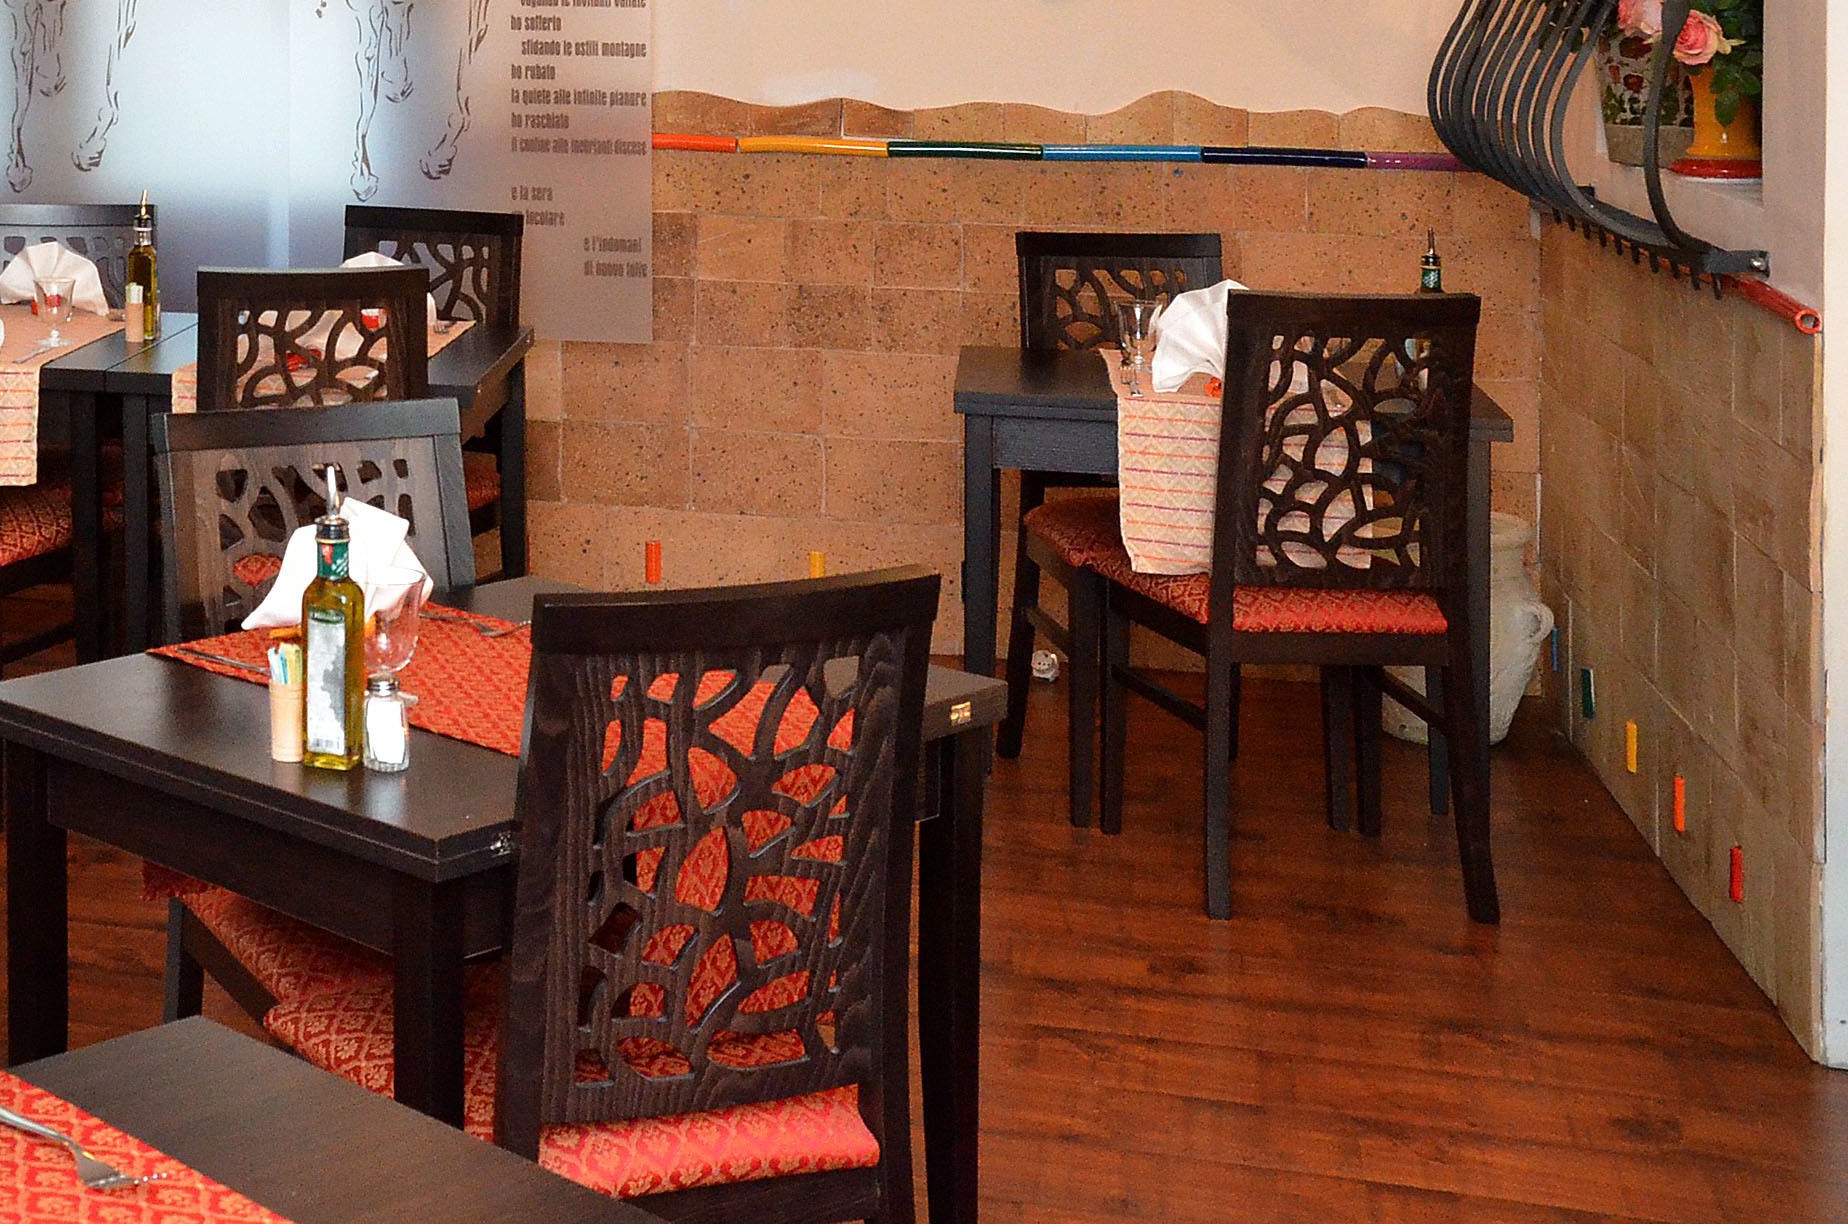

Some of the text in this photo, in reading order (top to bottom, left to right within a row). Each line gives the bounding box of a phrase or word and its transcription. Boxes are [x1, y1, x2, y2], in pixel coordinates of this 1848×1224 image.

[510, 14, 561, 31] ho sofferto
[521, 39, 646, 58] sfidando le ostili montagne
[511, 64, 555, 80] ho rubato
[511, 88, 646, 107] la quiete alle infinite pianure
[511, 112, 522, 128] ho
[512, 185, 553, 201] e la sera
